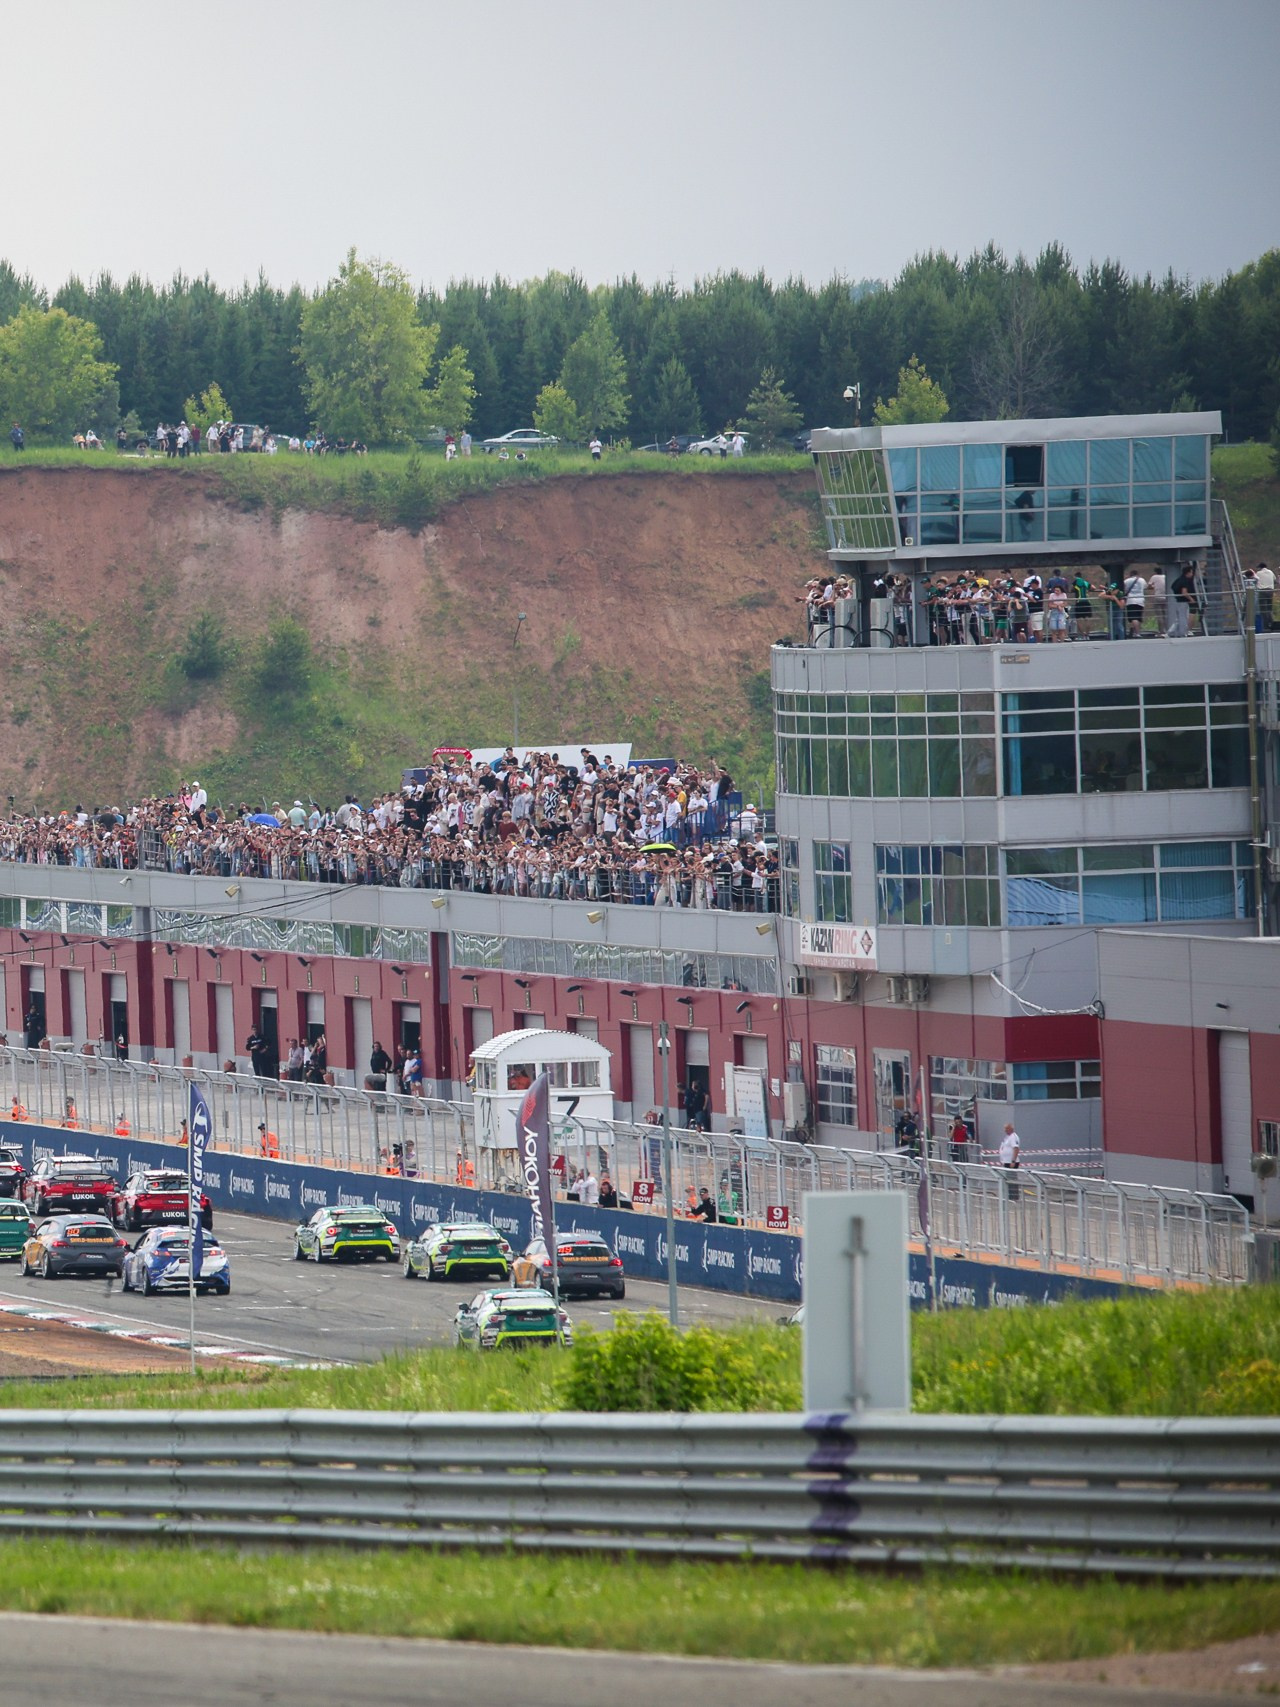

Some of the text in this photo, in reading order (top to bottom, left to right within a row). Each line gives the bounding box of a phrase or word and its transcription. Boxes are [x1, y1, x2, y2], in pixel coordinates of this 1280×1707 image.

[193, 1132, 203, 1182] SMP
[638, 1184, 649, 1195] 8
[633, 1195, 652, 1203] ROW
[772, 1207, 783, 1220] 9
